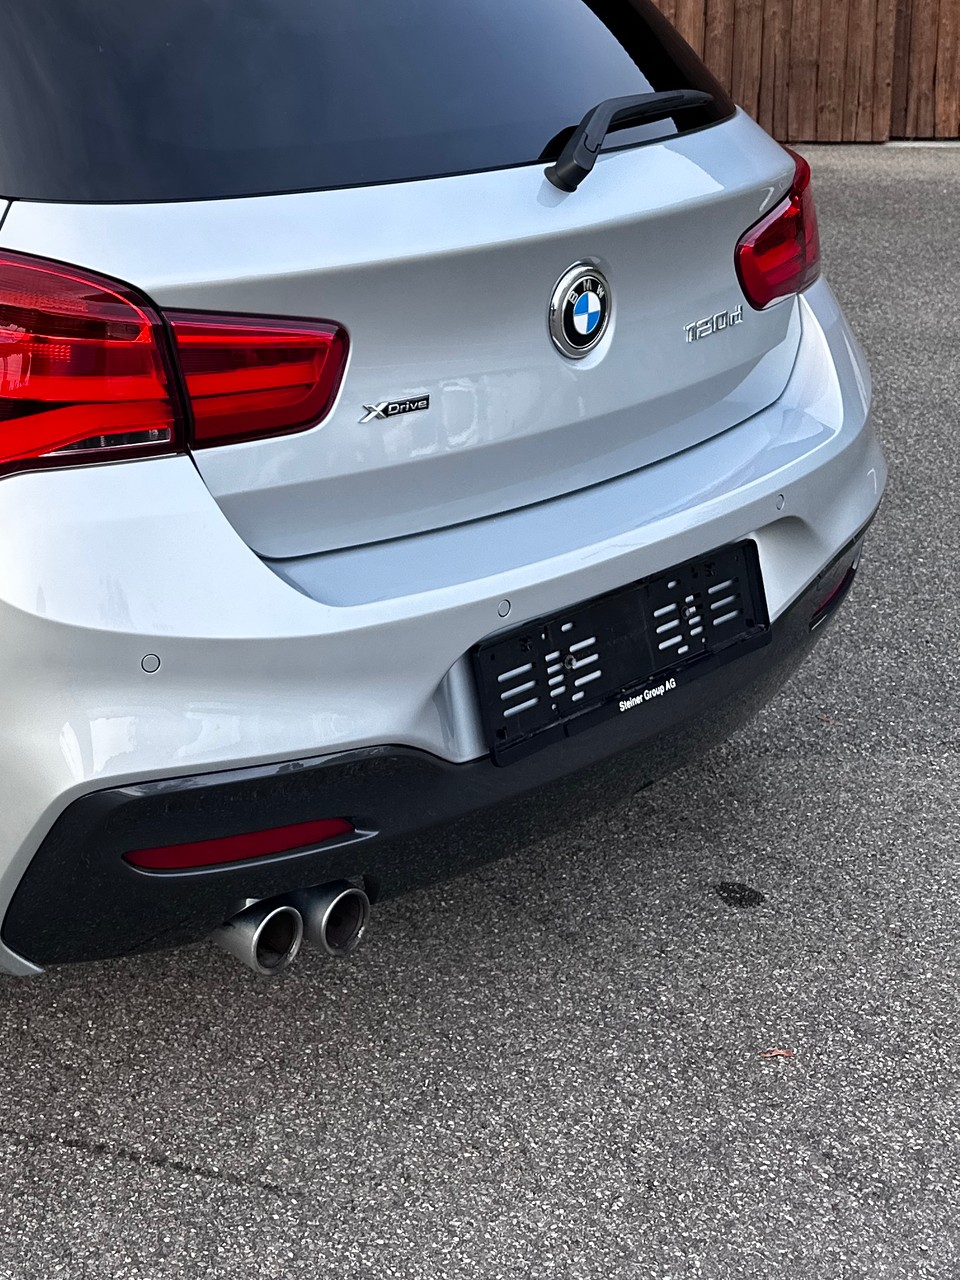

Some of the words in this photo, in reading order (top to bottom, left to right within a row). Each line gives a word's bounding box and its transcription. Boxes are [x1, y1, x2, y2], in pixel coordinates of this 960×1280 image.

[567, 279, 606, 304] BMW
[619, 694, 643, 712] Steiner
[643, 685, 665, 701] Group
[665, 677, 676, 691] AG
